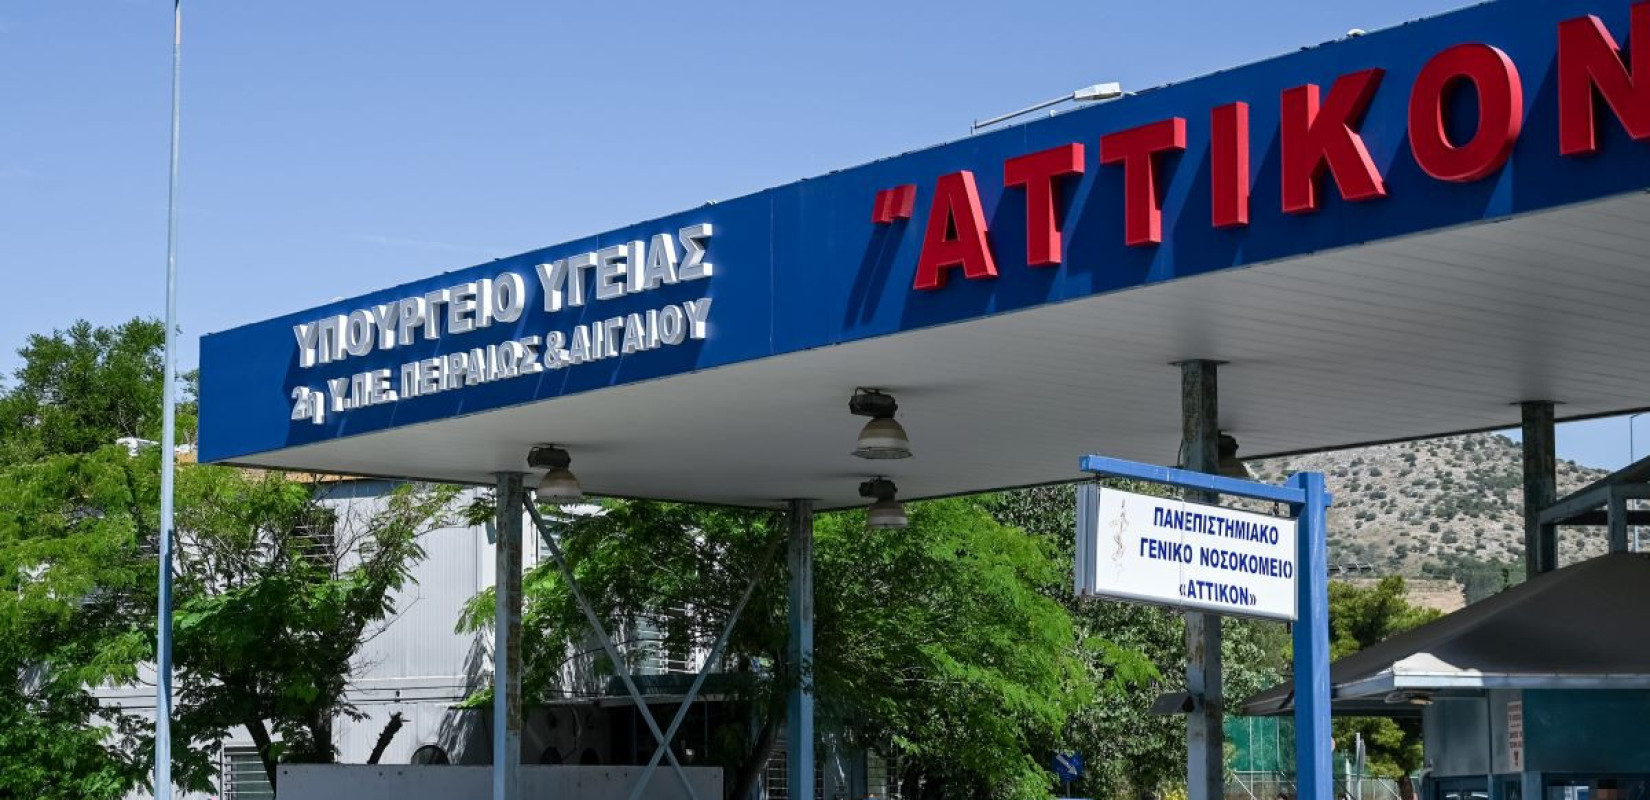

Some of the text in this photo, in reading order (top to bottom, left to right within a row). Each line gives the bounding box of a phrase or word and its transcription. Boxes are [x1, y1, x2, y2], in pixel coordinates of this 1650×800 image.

[293, 223, 712, 368] ΥΠΟΥΡΓΕΙΟ ΥΓΕΙΑΣ
[291, 386, 325, 424] 2η
[1153, 506, 1279, 546] ΠΑΝΕΠΙΣΤΗΜΙΑΚΟ
[1140, 537, 1293, 579] ΓΕΝΙΚΟ ΝΟΣΟΚΟΜΕΙΟ
[1179, 579, 1256, 606] «ΑΤΤΙΚΟΝ»
